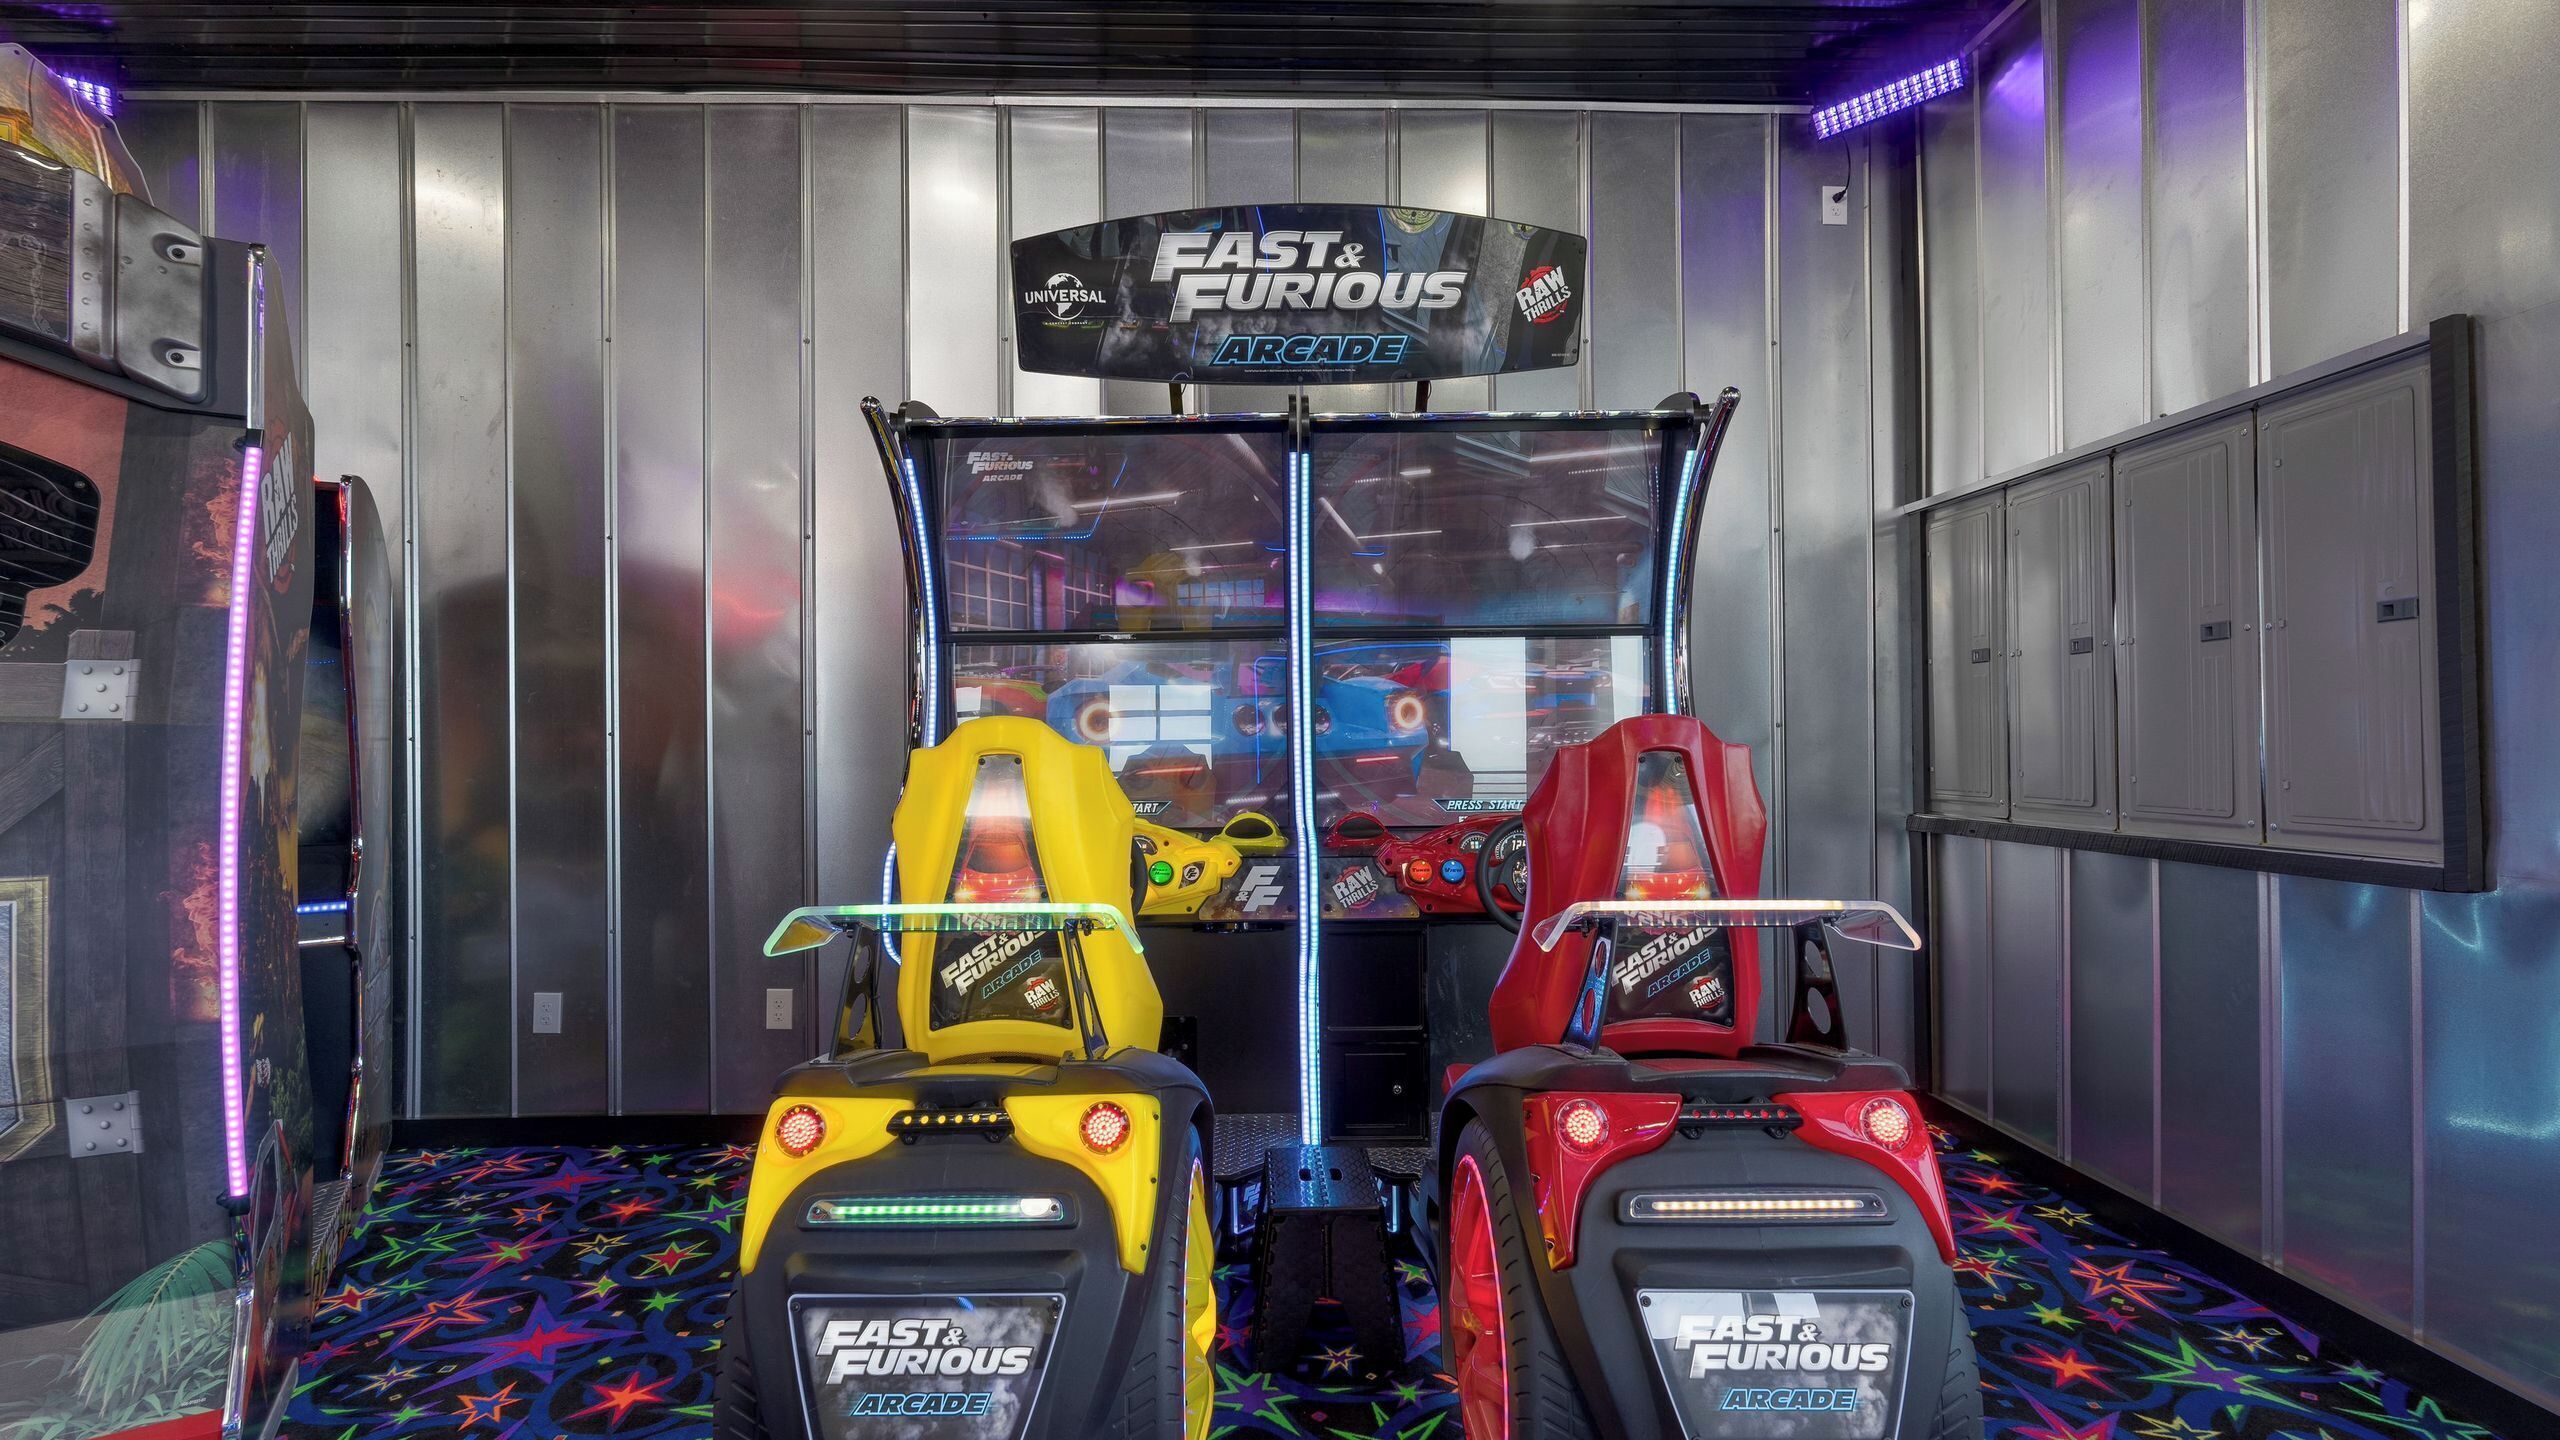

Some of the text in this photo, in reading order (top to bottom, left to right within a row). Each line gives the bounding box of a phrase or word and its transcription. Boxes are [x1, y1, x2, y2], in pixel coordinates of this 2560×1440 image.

[1025, 289, 1107, 304] UNIVERSAL
[1168, 271, 1469, 324] FURIOUS
[1516, 266, 1565, 311] RAW
[1523, 285, 1572, 322] THRILLS
[1211, 334, 1409, 366] ARCADE
[971, 461, 1034, 475] FURIOUS
[982, 474, 1024, 482] ARCADE
[261, 432, 294, 545] RAW
[266, 494, 298, 584] THRILLS
[1132, 803, 1159, 813] TART
[1446, 800, 1523, 810] PRESS START
[1332, 865, 1374, 899] RAW
[1339, 880, 1379, 909] THRILLS
[982, 949, 1042, 999] ARCADE
[1647, 947, 1711, 998] ARCADE
[1024, 979, 1056, 1004] RAW
[1030, 989, 1060, 1010] THRILLS
[1688, 978, 1721, 1003] RAW
[1694, 987, 1725, 1008] THRILLS
[825, 1346, 1034, 1386] FURIOUS
[1689, 1343, 1891, 1380] FURIOUS
[851, 1392, 992, 1416] ARCADE
[1721, 1388, 1857, 1411] ARCADE
